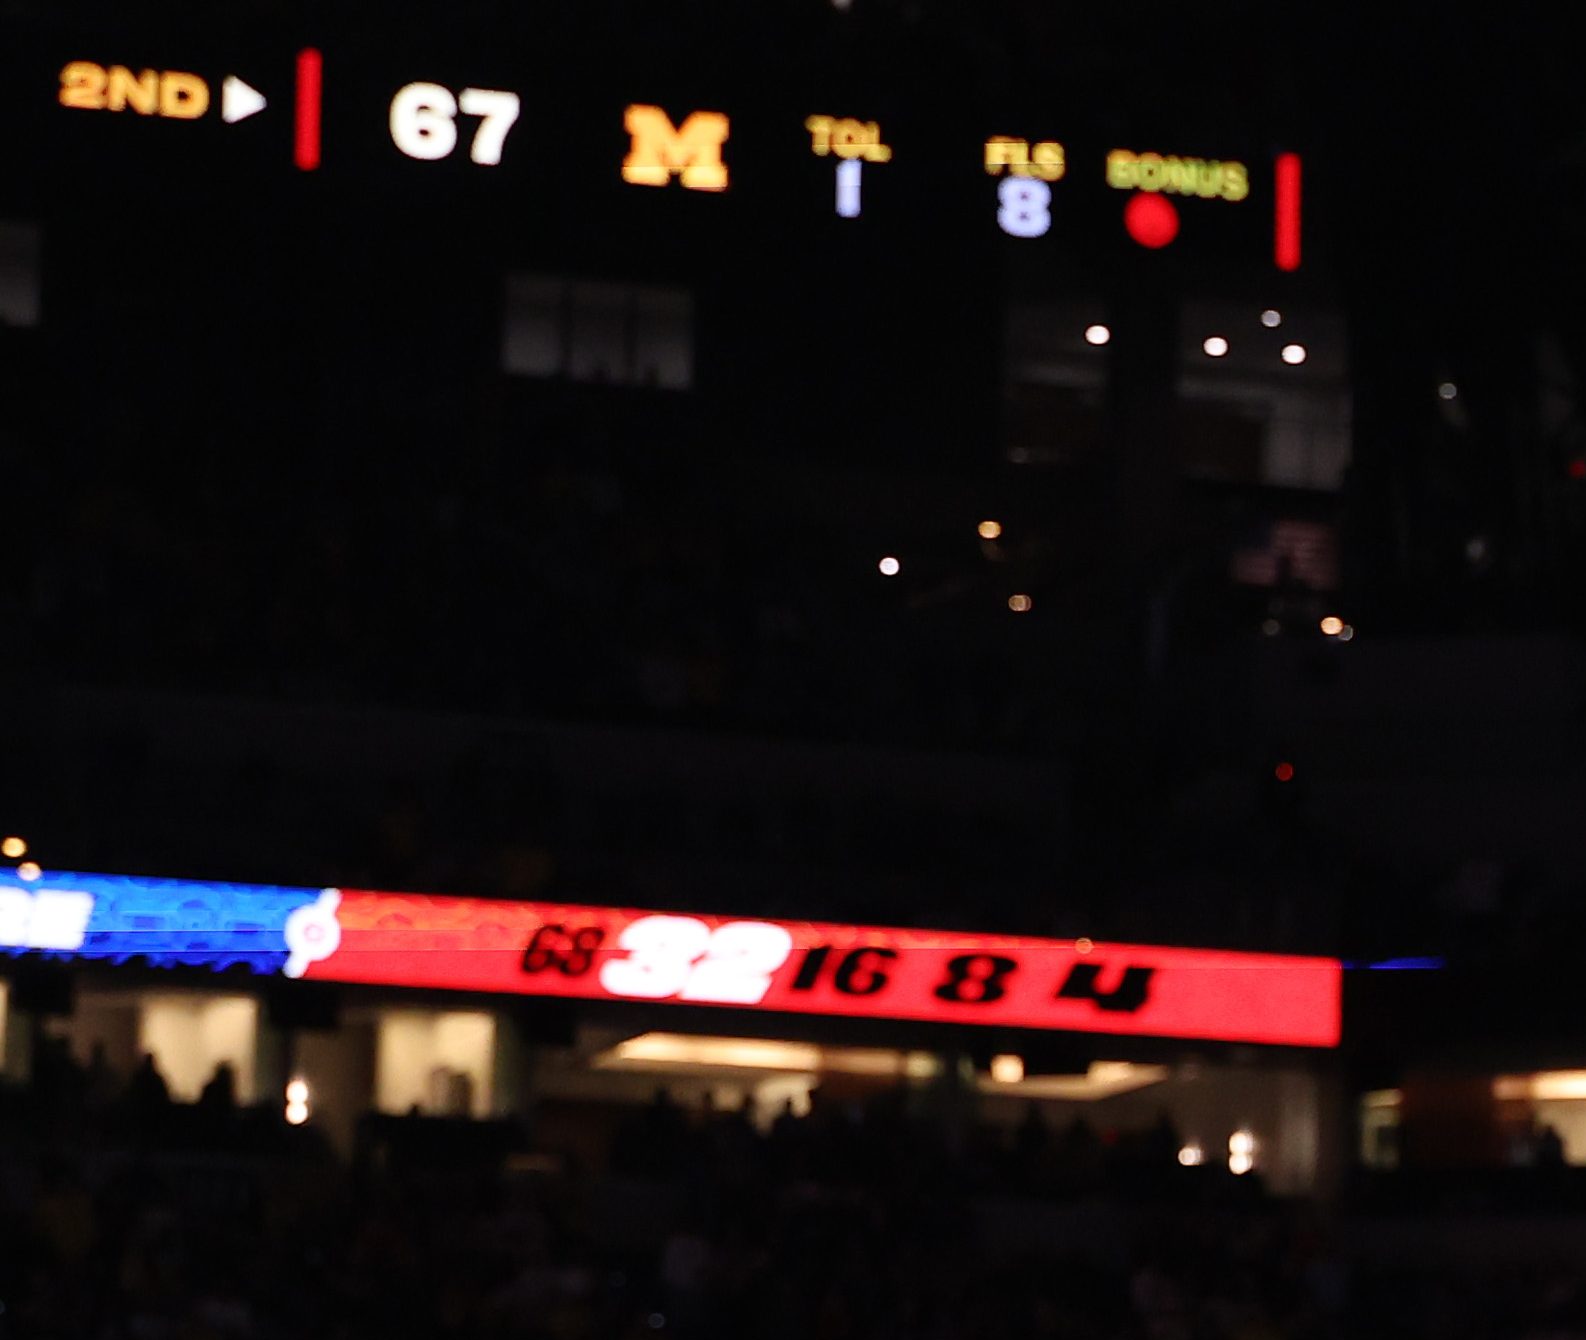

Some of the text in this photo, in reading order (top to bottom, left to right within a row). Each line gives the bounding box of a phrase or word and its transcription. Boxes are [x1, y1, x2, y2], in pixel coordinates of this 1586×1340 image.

[59, 62, 208, 120] 2ND
[390, 81, 520, 165] 67
[623, 105, 729, 191] M
[1107, 149, 1249, 202] BONUS
[997, 176, 1051, 238] 8
[600, 915, 792, 1004] 32
[791, 945, 896, 995] 16
[936, 954, 1017, 1002] 8
[1056, 961, 1156, 1013] 4
